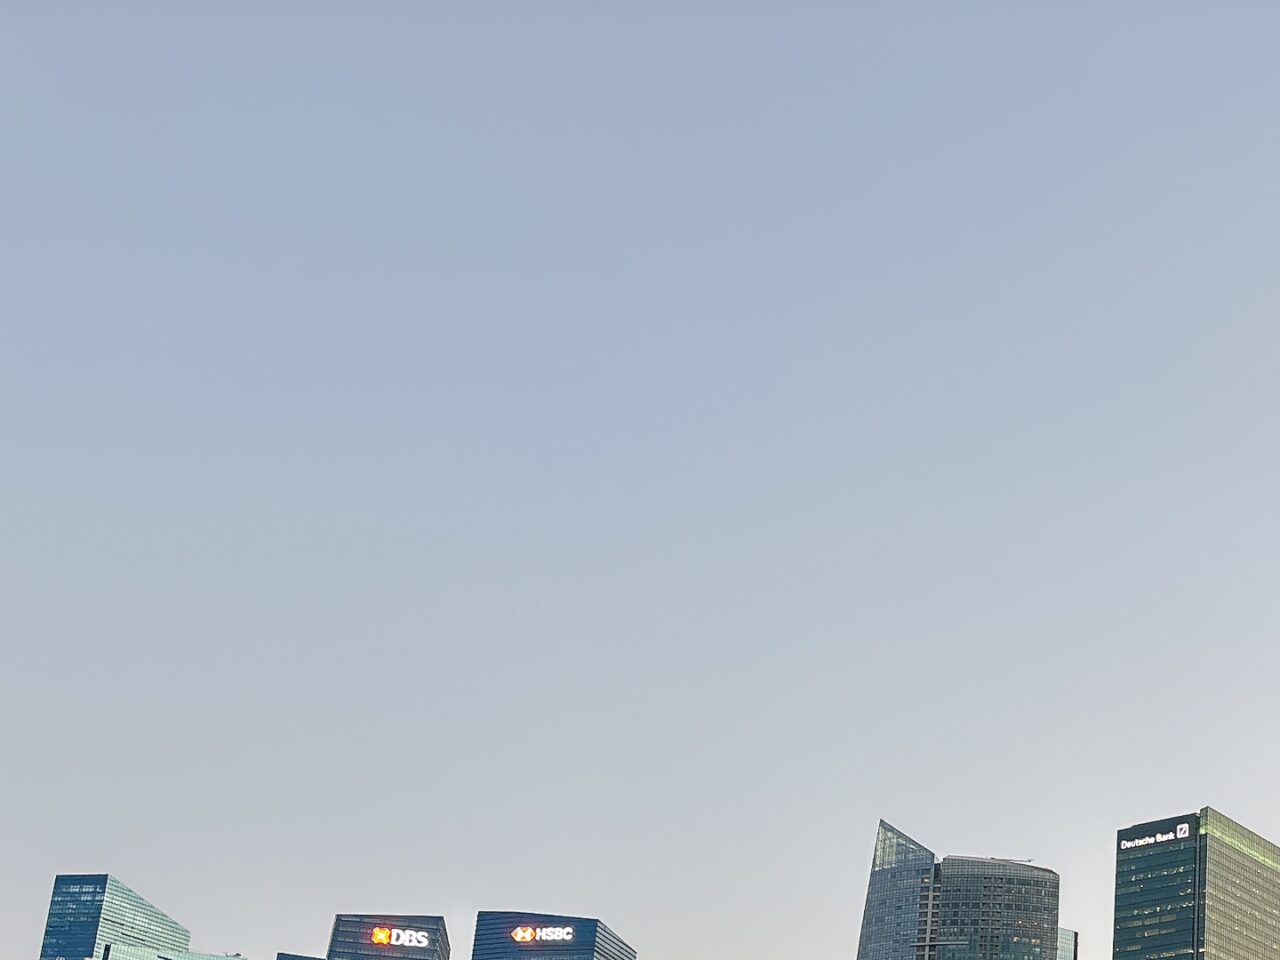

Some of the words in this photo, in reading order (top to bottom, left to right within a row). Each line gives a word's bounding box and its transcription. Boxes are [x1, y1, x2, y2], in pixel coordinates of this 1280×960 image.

[1121, 836, 1155, 849] Deutsche
[1155, 832, 1175, 842] Bank
[390, 928, 429, 947] DBS
[535, 927, 573, 940] HSBC
